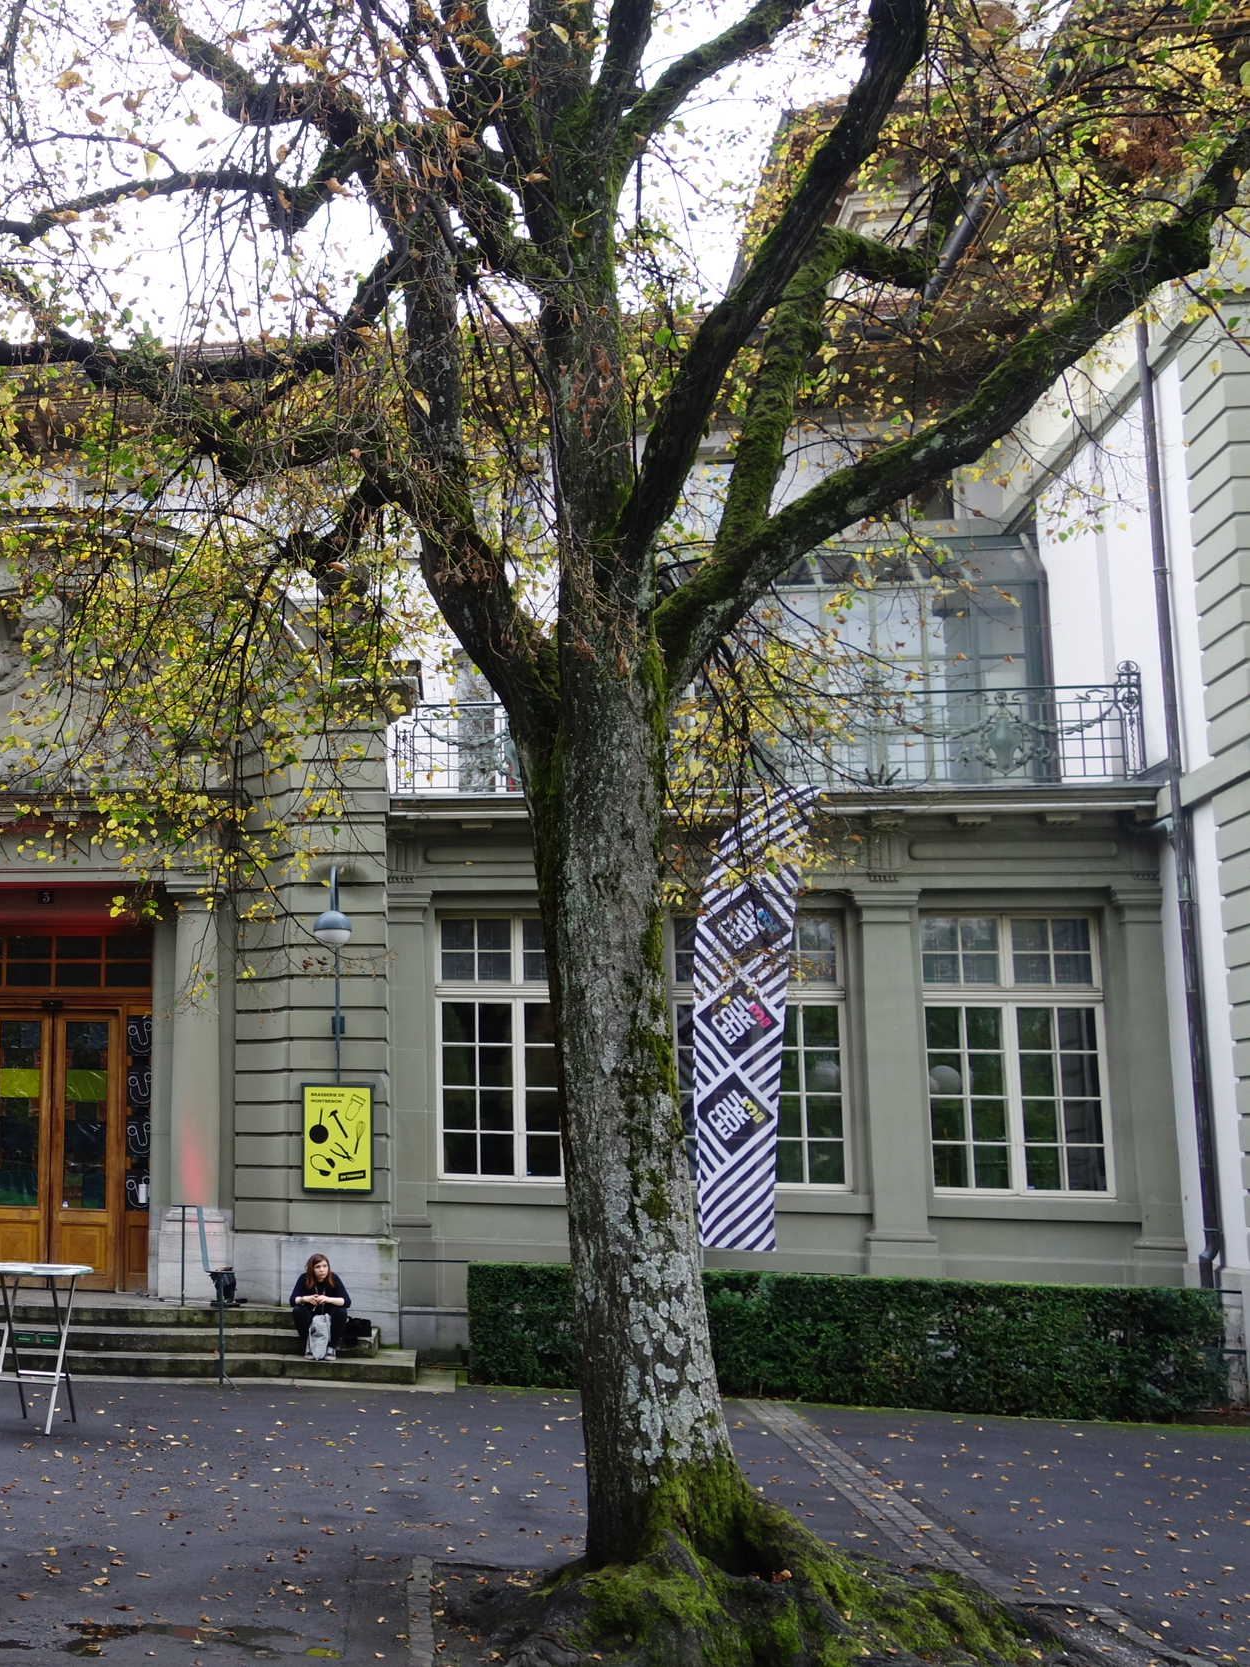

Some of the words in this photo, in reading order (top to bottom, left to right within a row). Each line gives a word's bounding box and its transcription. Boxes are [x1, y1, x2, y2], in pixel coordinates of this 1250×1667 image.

[42, 892, 50, 903] 3
[711, 994, 756, 1032] COUL
[708, 1089, 748, 1127] COUL
